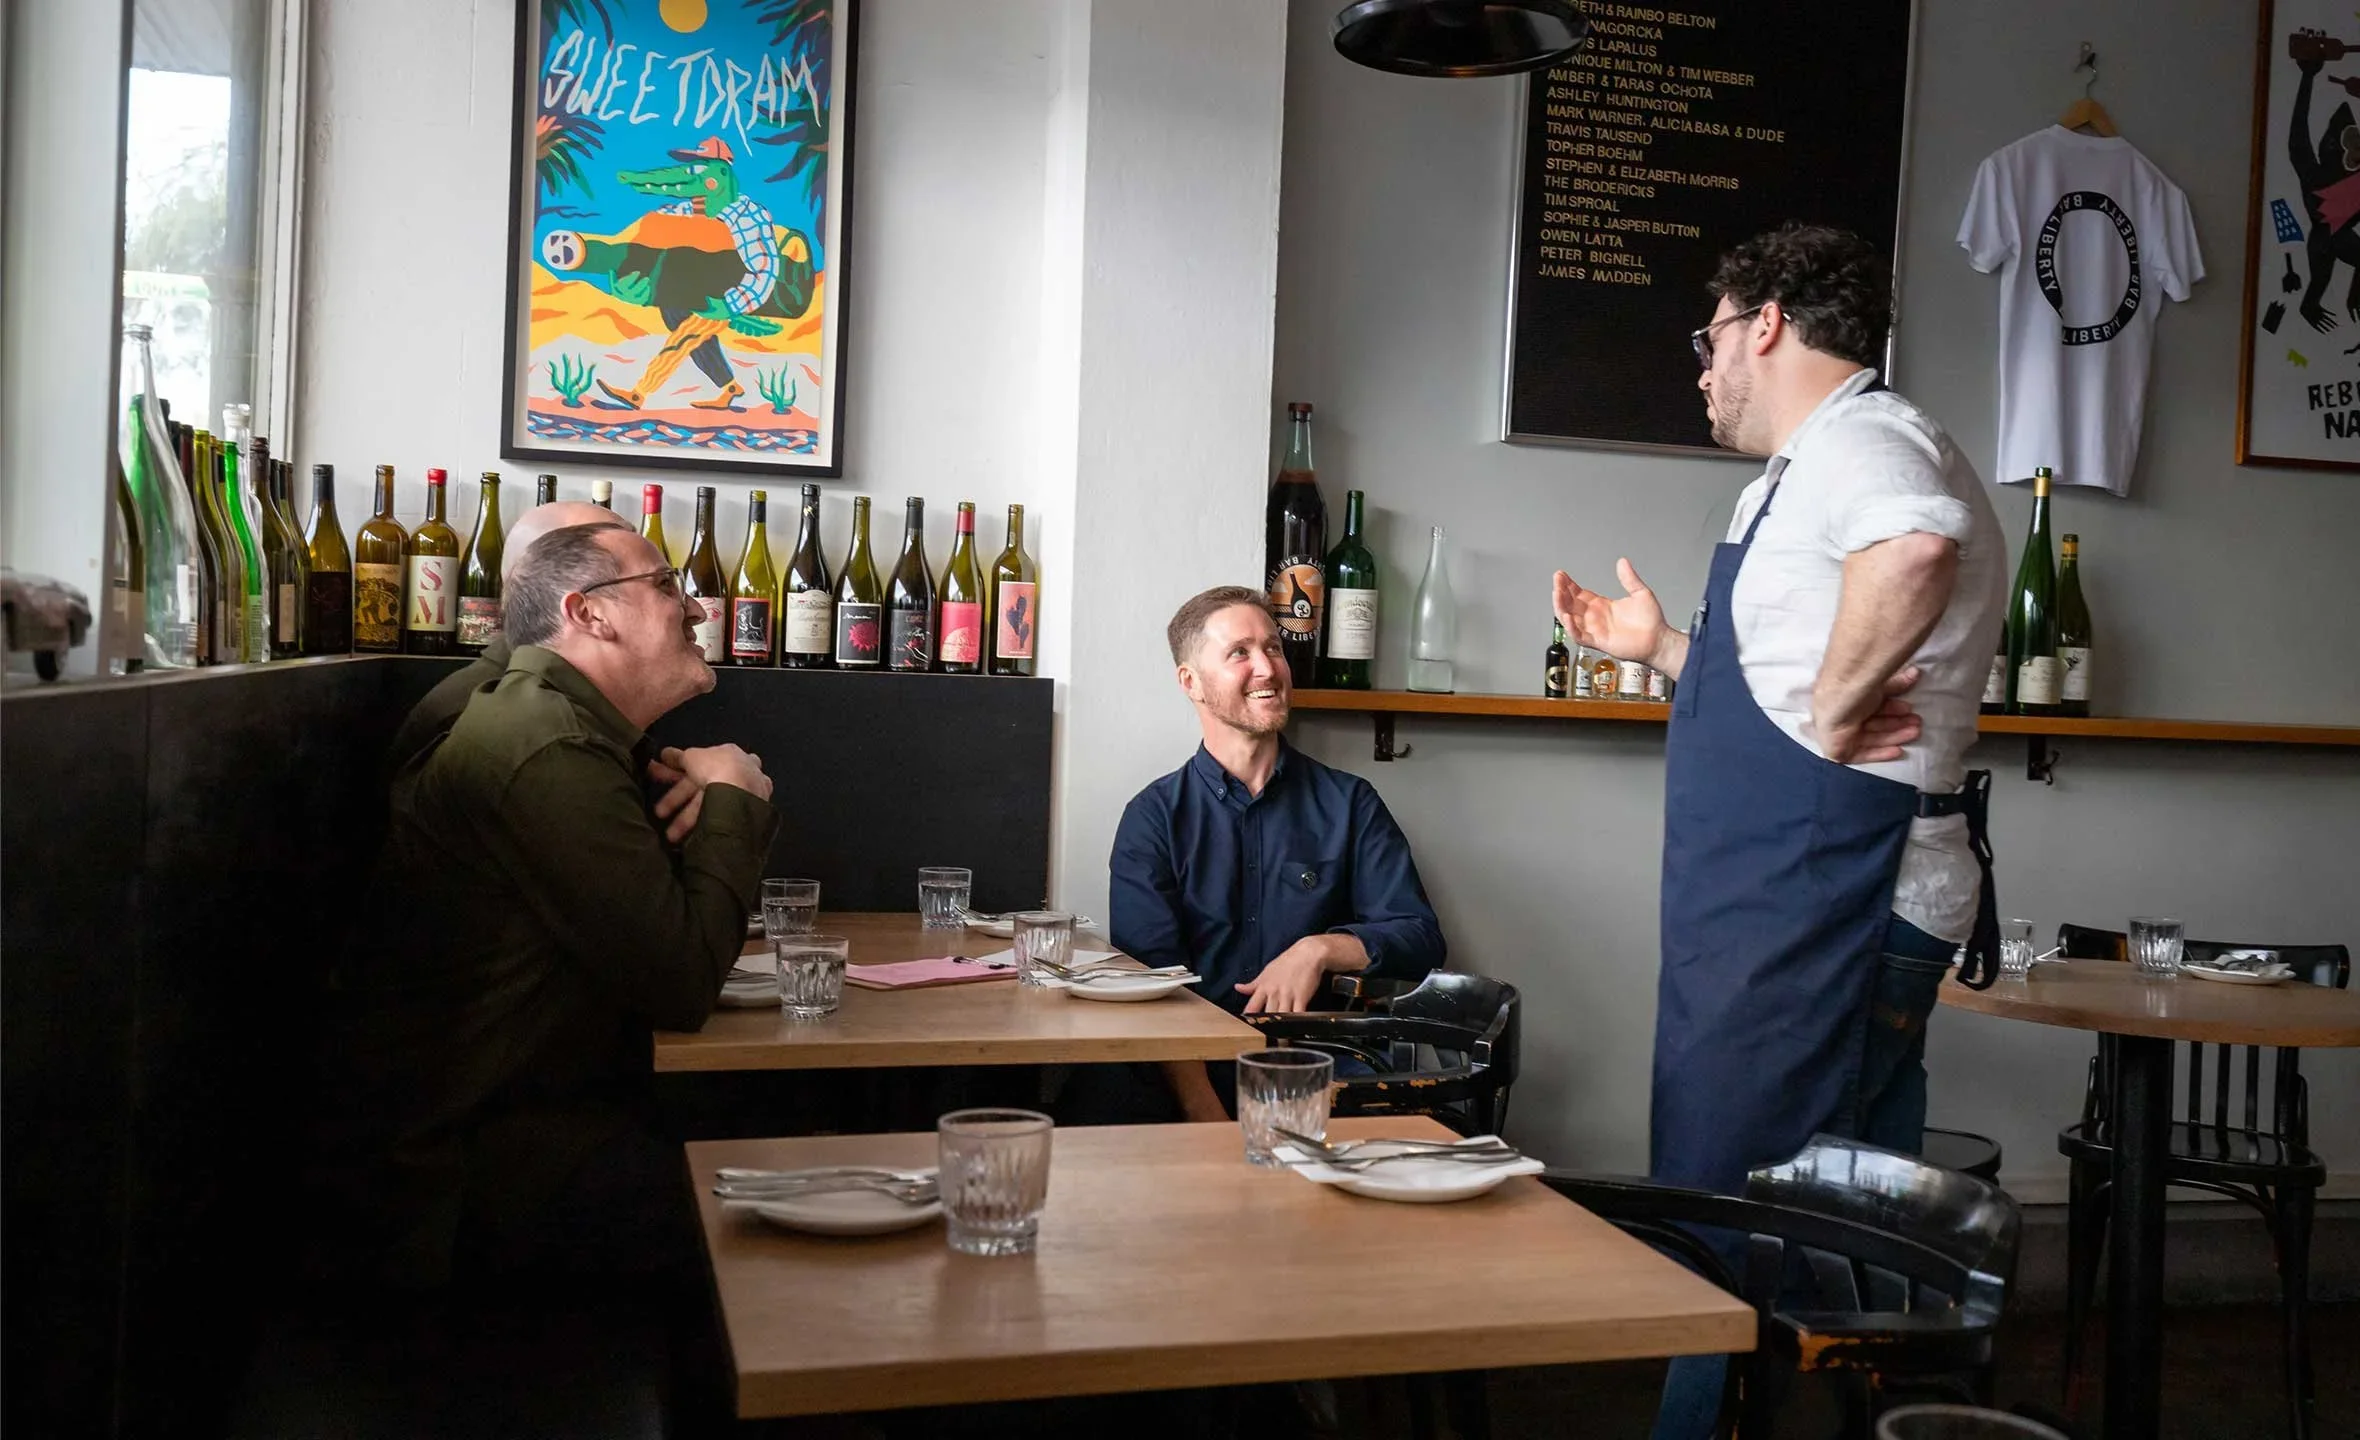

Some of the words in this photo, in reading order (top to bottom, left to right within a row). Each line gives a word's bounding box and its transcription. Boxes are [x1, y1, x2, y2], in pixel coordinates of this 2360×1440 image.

[1605, 3, 1614, 16] &
[1616, 5, 1665, 22] RAINBO
[1668, 12, 1716, 30] BELTON
[1600, 39, 1657, 57] LAPALUS
[1547, 68, 1595, 85] AMBER
[1600, 74, 1610, 88] &
[1613, 75, 1655, 92] TARAS
[1660, 82, 1713, 100] OCHOTA
[1565, 54, 1613, 70] NIQUE
[1615, 60, 1662, 75] MILTON
[1666, 65, 1675, 77] &
[1680, 66, 1700, 81] TIM
[1702, 68, 1754, 87] WEBBER
[1546, 86, 1600, 103] ASHLEY
[1606, 93, 1689, 114] HUNTINGTON
[1546, 103, 1585, 120] MARK
[1734, 126, 1743, 138] &
[1746, 127, 1785, 143] DUDE
[1546, 121, 1592, 138] TRAVIS
[1595, 127, 1653, 145] TAUSEND
[1546, 139, 1595, 157] TOPHER
[1597, 144, 1644, 162] BOEHM
[1543, 174, 1569, 189] THE
[1573, 178, 1656, 199] BRODERICKS
[1545, 158, 1603, 174] STEPHEN
[1608, 164, 1617, 177] &
[1620, 165, 1687, 185] ELIZABETH
[1689, 173, 1740, 190] MORRIS
[1543, 192, 1567, 207] TIM
[1568, 195, 1621, 213] SPROAL
[1540, 229, 1580, 244] OWEN
[1584, 232, 1624, 248] LATTA
[1543, 211, 1590, 227] SOPHIE
[1592, 216, 1601, 228] &
[1604, 217, 1650, 233] JASPER
[1652, 222, 1700, 239] BUTTON
[1540, 246, 1582, 261] PETER
[1590, 251, 1646, 268] BIGNELL
[2038, 215, 2060, 291] LIBERTY
[1538, 264, 1587, 280] JAMES
[1592, 269, 1652, 286] MADDEN
[2125, 274, 2140, 309] BAR
[2063, 316, 2121, 344] LIBERTY
[2307, 380, 2360, 411] REB
[419, 561, 443, 591] S
[413, 595, 446, 624] M
